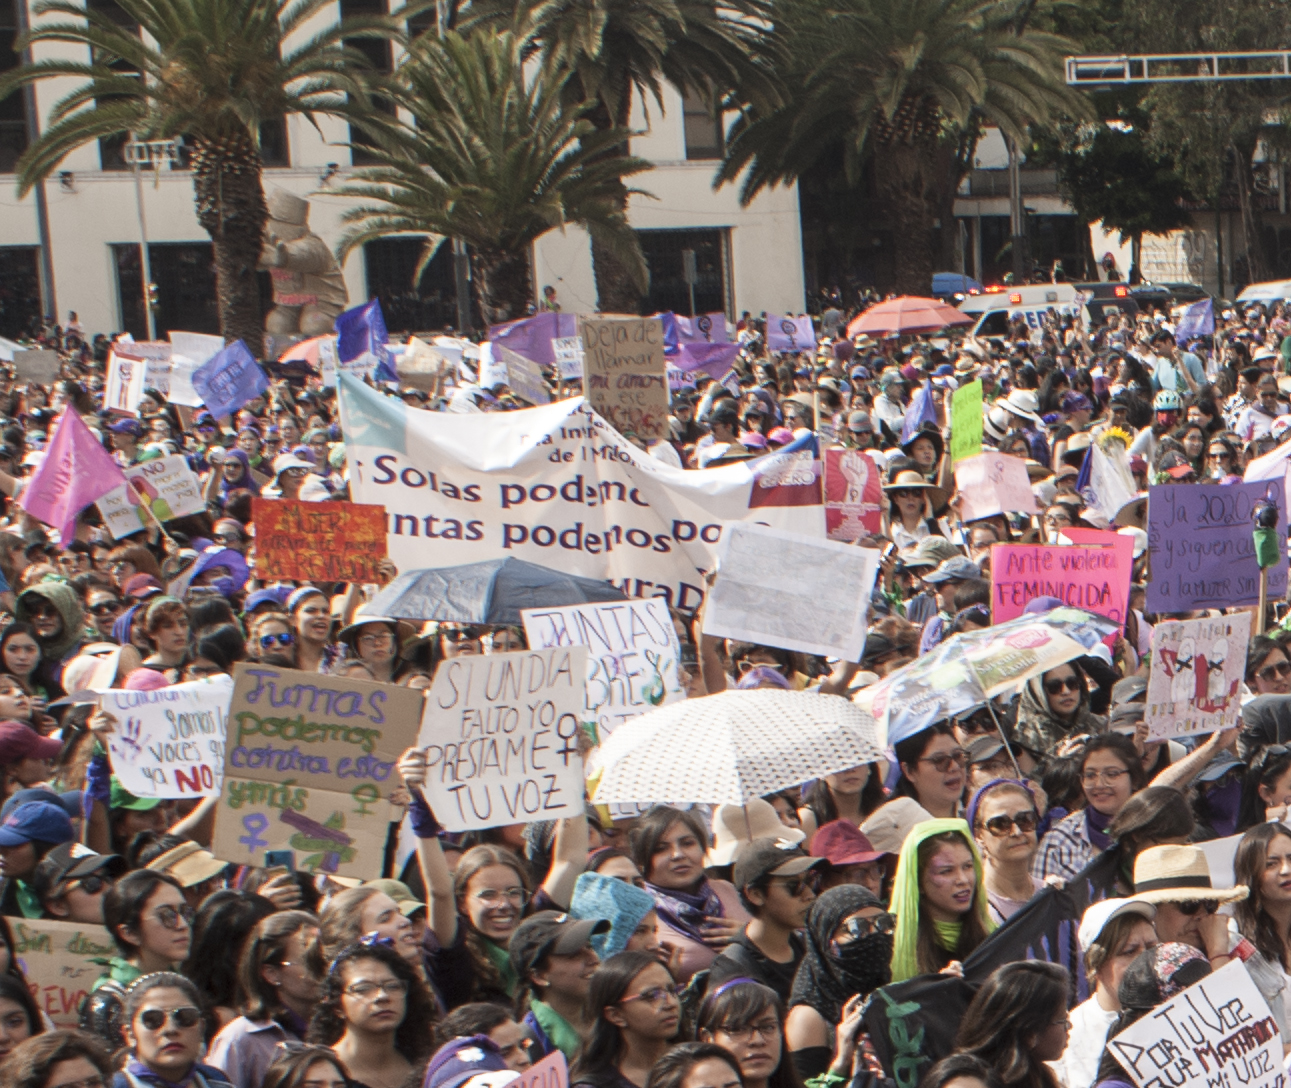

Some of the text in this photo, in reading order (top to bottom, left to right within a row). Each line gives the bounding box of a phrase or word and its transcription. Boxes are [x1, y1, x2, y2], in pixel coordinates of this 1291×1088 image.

[583, 321, 629, 350] Deja
[141, 461, 165, 478] NO
[1197, 489, 1250, 525] 2020
[995, 581, 1113, 608] FEMINICIDA
[437, 657, 524, 711] SI UN
[234, 710, 382, 753] podemos
[460, 704, 520, 739] FALTO
[527, 699, 556, 731] YO
[173, 764, 214, 793] NO
[230, 745, 397, 782] contra esto
[447, 773, 568, 824] TU VOZ
[1113, 984, 1254, 1081] POR TU VOZ
[1231, 1048, 1276, 1086] VOZ
